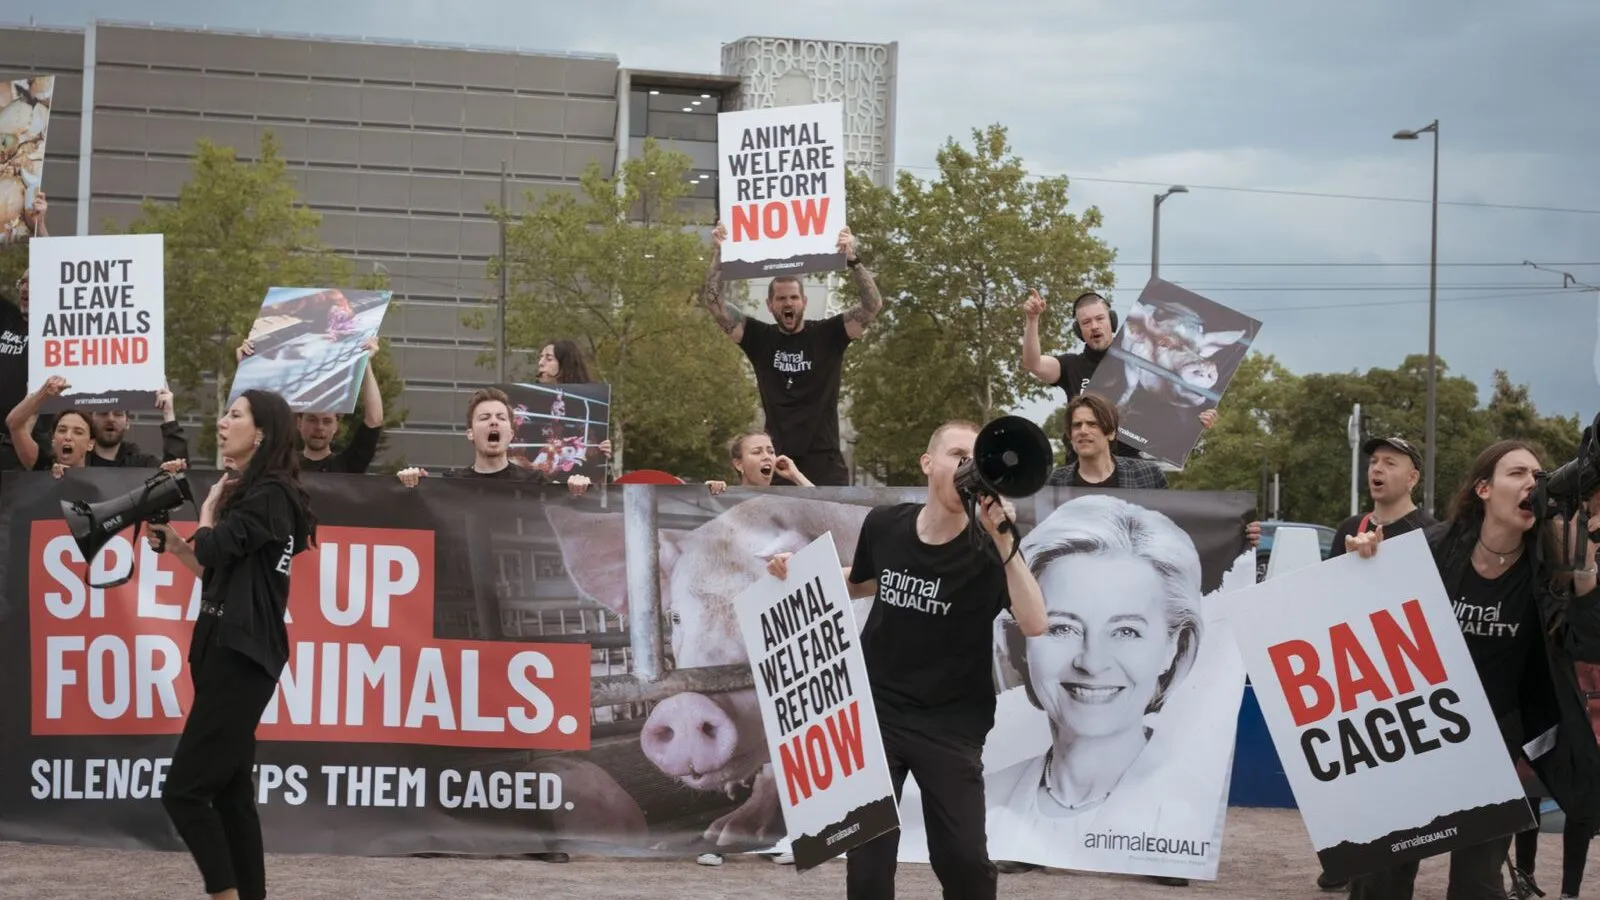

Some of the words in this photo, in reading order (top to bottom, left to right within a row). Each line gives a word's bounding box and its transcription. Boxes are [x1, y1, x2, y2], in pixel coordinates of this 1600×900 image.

[740, 122, 827, 151] ANIMAL
[728, 146, 834, 177] WELFARE
[737, 172, 827, 201] REFORM
[732, 197, 830, 242] NOW
[60, 259, 133, 284] DON'T
[58, 285, 135, 310] LEAVE
[42, 310, 151, 337] ANIMALS
[44, 337, 149, 367] BEHIND
[319, 542, 420, 628] UP
[880, 568, 941, 599] animal
[760, 575, 834, 652] ANIMAL
[880, 584, 952, 616] EQUALITY
[1460, 620, 1520, 637] ALITY
[758, 610, 851, 697] WELFARE
[1267, 599, 1449, 728] BAN
[46, 634, 183, 719] FOR
[259, 641, 578, 735] NIMALS.
[774, 657, 853, 737] REFORM
[1299, 687, 1471, 782] CAGES
[779, 700, 865, 807] NOW
[31, 758, 173, 800] SILENCE
[321, 765, 427, 807] THEM
[438, 769, 575, 810] CAGED.
[1390, 826, 1458, 853] animalEQUALITY
